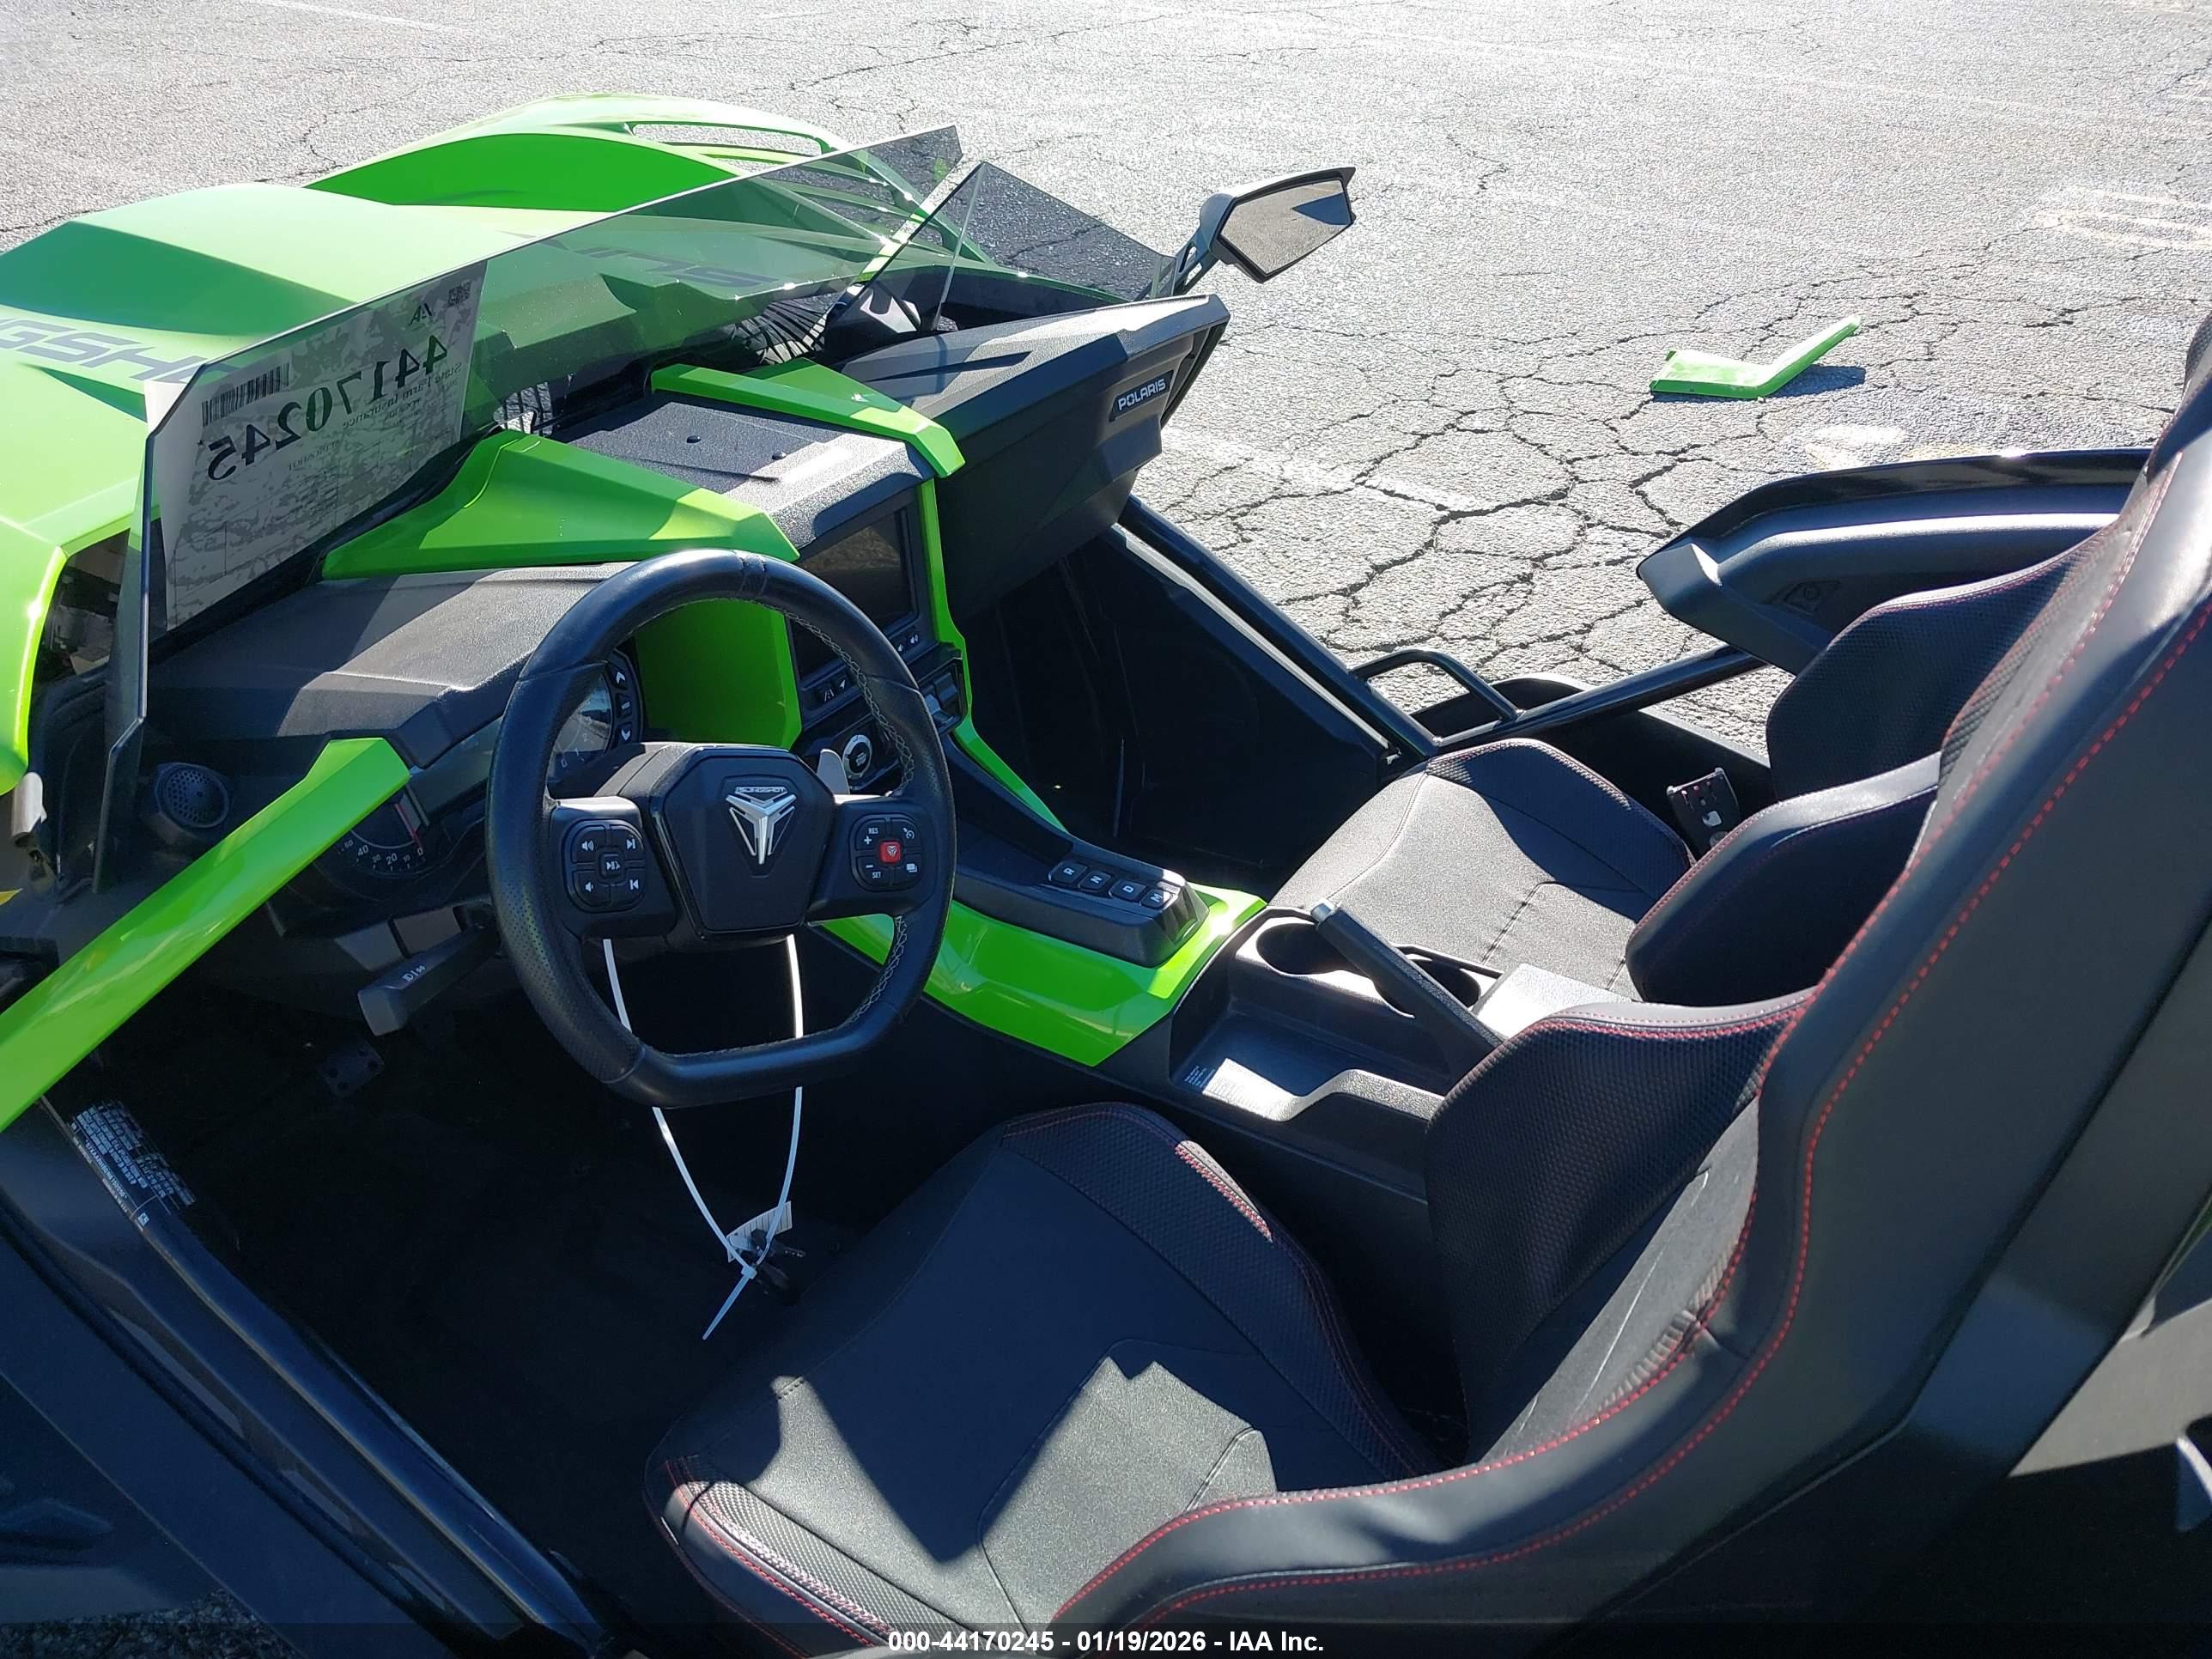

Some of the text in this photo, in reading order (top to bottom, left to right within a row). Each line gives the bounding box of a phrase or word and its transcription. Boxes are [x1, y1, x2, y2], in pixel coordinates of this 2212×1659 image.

[1117, 378, 1167, 410] POLARIS
[357, 845, 369, 857] 40
[386, 853, 398, 866] 20
[872, 871, 881, 879] SET
[1063, 866, 1075, 876] R
[1090, 875, 1103, 884] N
[1122, 885, 1134, 894] D
[1151, 893, 1163, 903] M
